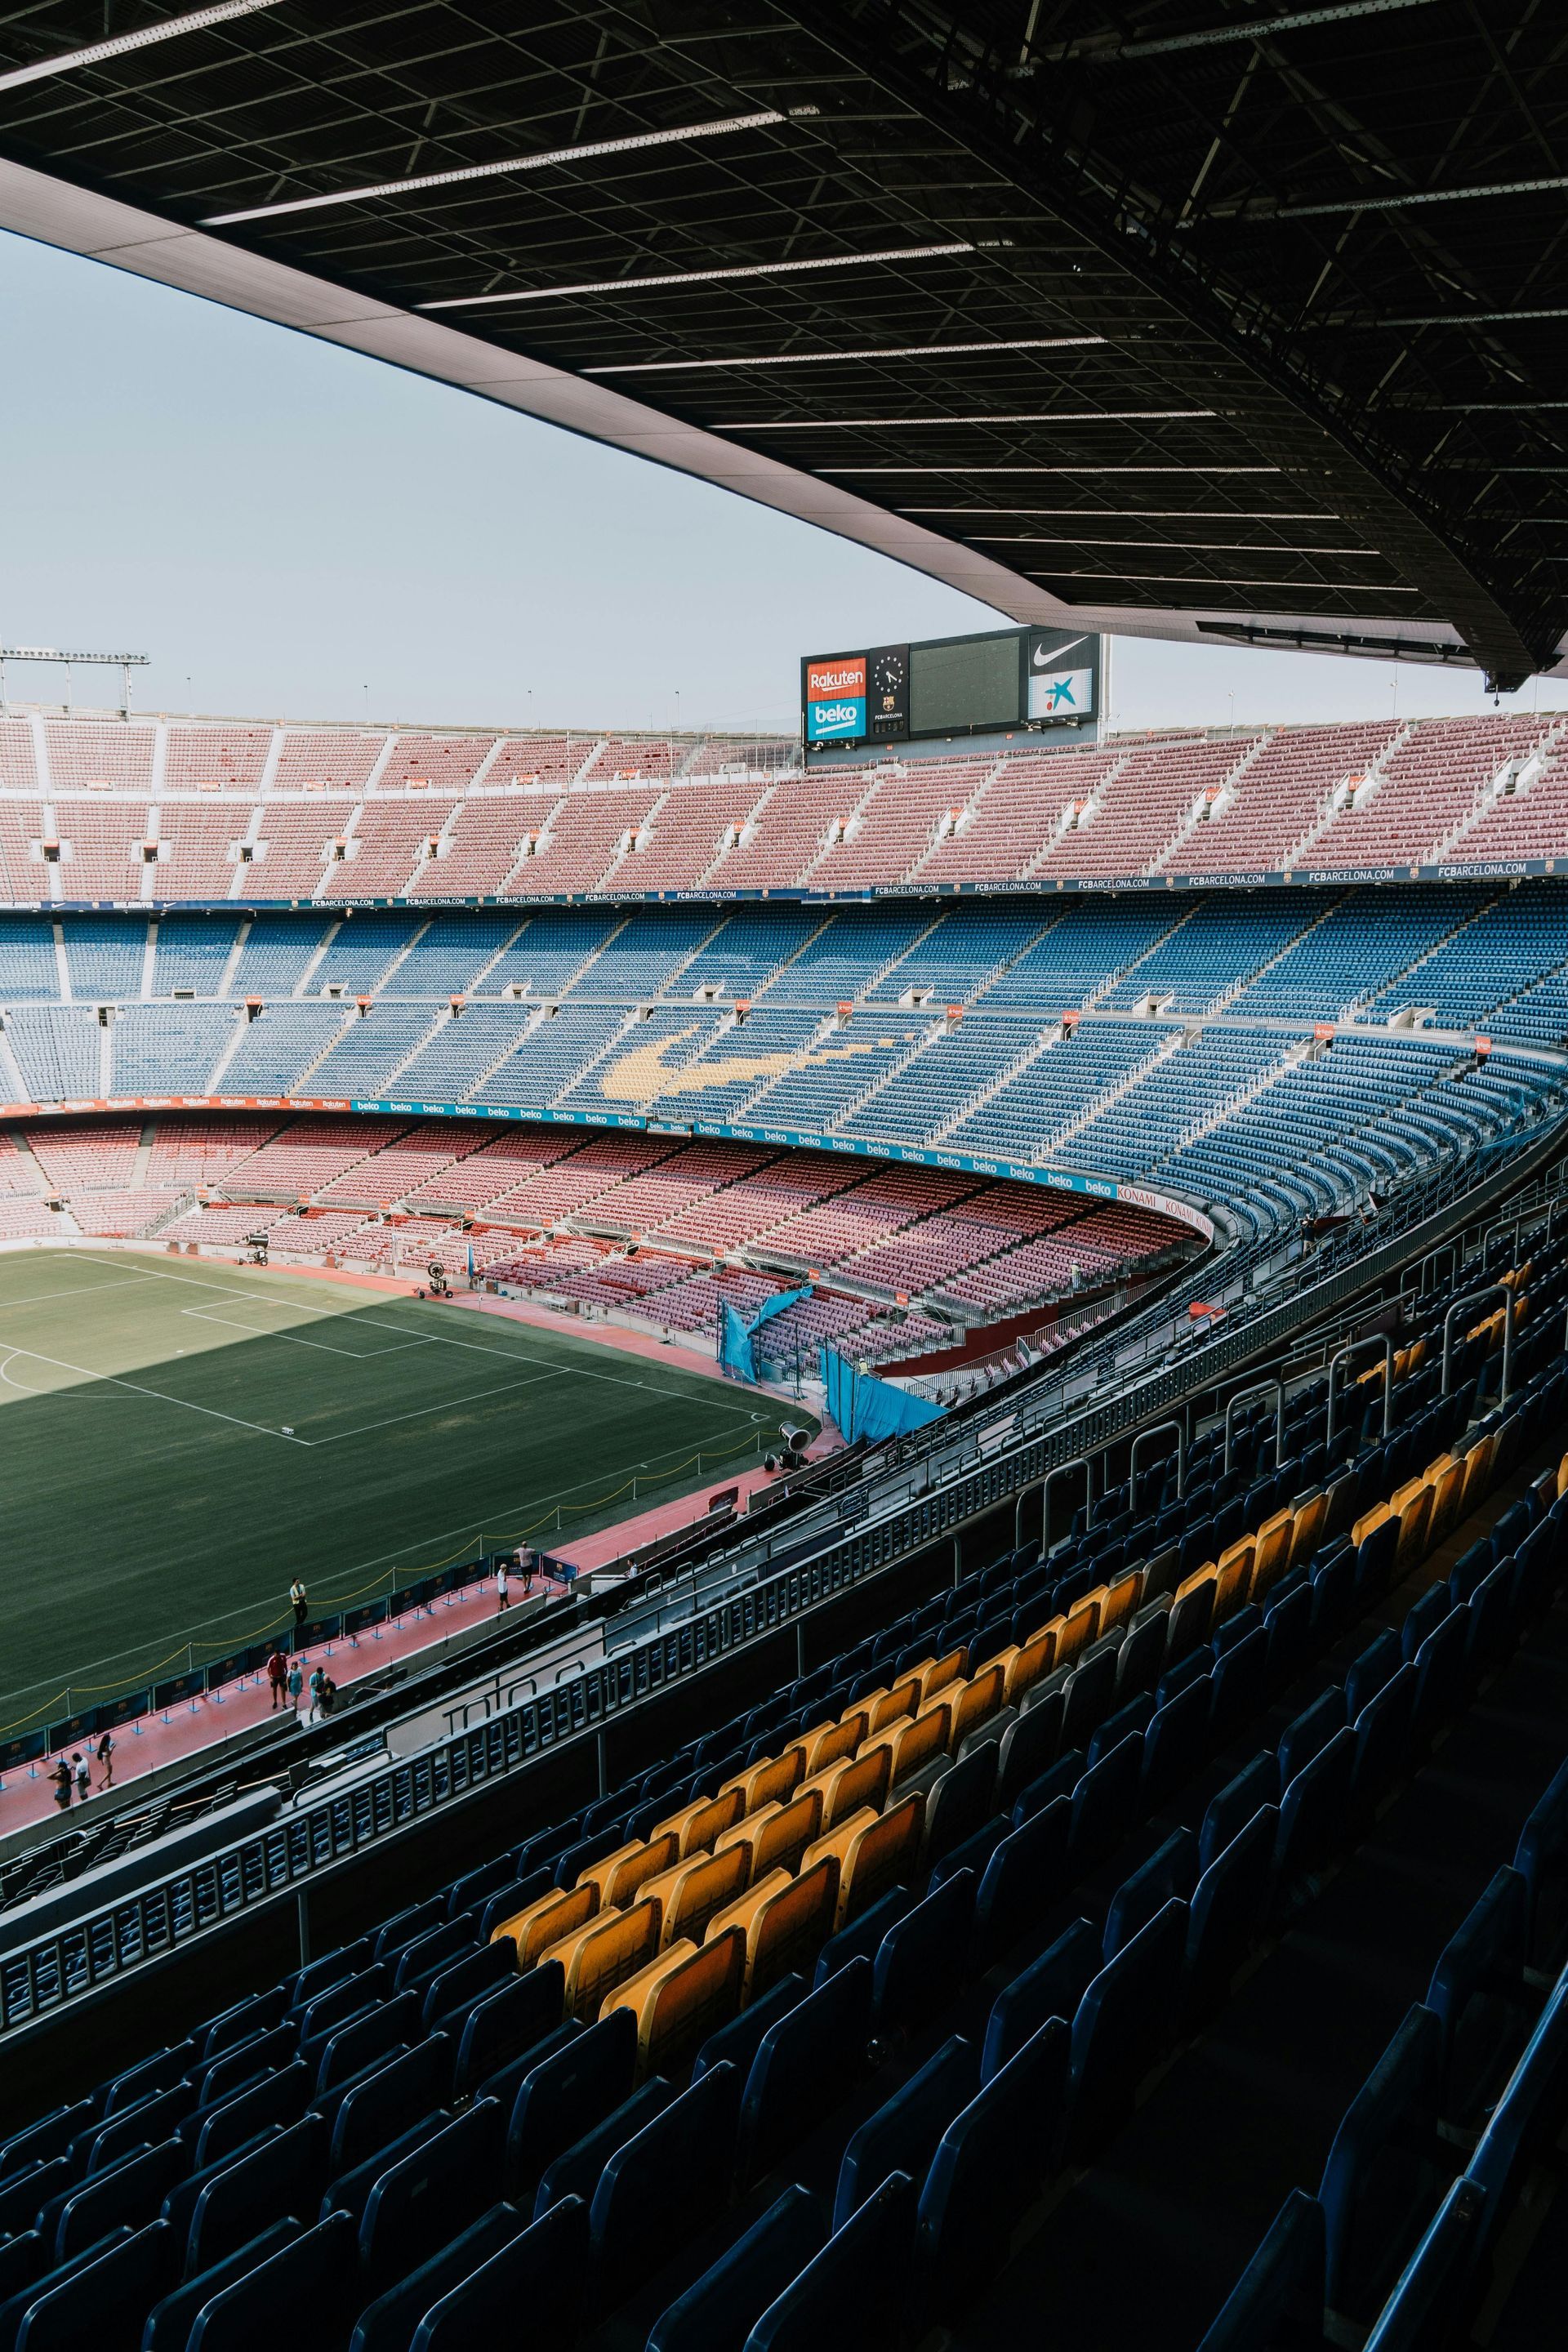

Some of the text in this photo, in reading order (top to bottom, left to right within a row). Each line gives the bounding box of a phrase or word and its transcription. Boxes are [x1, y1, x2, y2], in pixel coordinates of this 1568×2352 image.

[811, 670, 863, 688] Rakuten
[815, 704, 858, 724] beko
[1308, 869, 1394, 882] FCBARCELONA.COM
[1438, 863, 1526, 877] FCBARCELONA.COM
[1078, 879, 1149, 889] FCBARCELONA.COM
[1189, 874, 1265, 886] FCBARCELONA.COM
[875, 885, 939, 894] FCBARCELONA.COM
[974, 882, 1041, 892] FCBARCELONA.COM
[496, 896, 555, 904] FCBARCELONA.COM
[586, 893, 645, 902] FCBARCELONA.COM
[677, 891, 737, 899] FCBARCELONA.COM
[182, 1098, 210, 1106] Rakuten
[220, 1098, 246, 1106] Rakuten
[323, 1100, 346, 1108] Rakuten
[357, 1102, 380, 1111] beko
[390, 1103, 412, 1111] beko
[423, 1104, 444, 1113] beko
[455, 1105, 477, 1115] beko
[488, 1107, 509, 1116] beko
[520, 1108, 541, 1119] beko
[553, 1111, 575, 1121] beko
[586, 1113, 608, 1124] beko
[618, 1116, 639, 1127] beko
[698, 1122, 720, 1135] beko
[731, 1126, 753, 1138] beko
[764, 1130, 787, 1143] beko
[799, 1134, 821, 1147] beko
[832, 1138, 855, 1152] beko
[866, 1143, 890, 1156] beko
[902, 1148, 924, 1162] beko
[937, 1153, 960, 1168] beko
[973, 1159, 997, 1174] beko
[1009, 1165, 1035, 1181] beko
[1047, 1173, 1072, 1188] beko
[1085, 1180, 1111, 1196] beko
[1117, 1187, 1156, 1208] KONAMI
[1165, 1201, 1193, 1223] KONAMI
